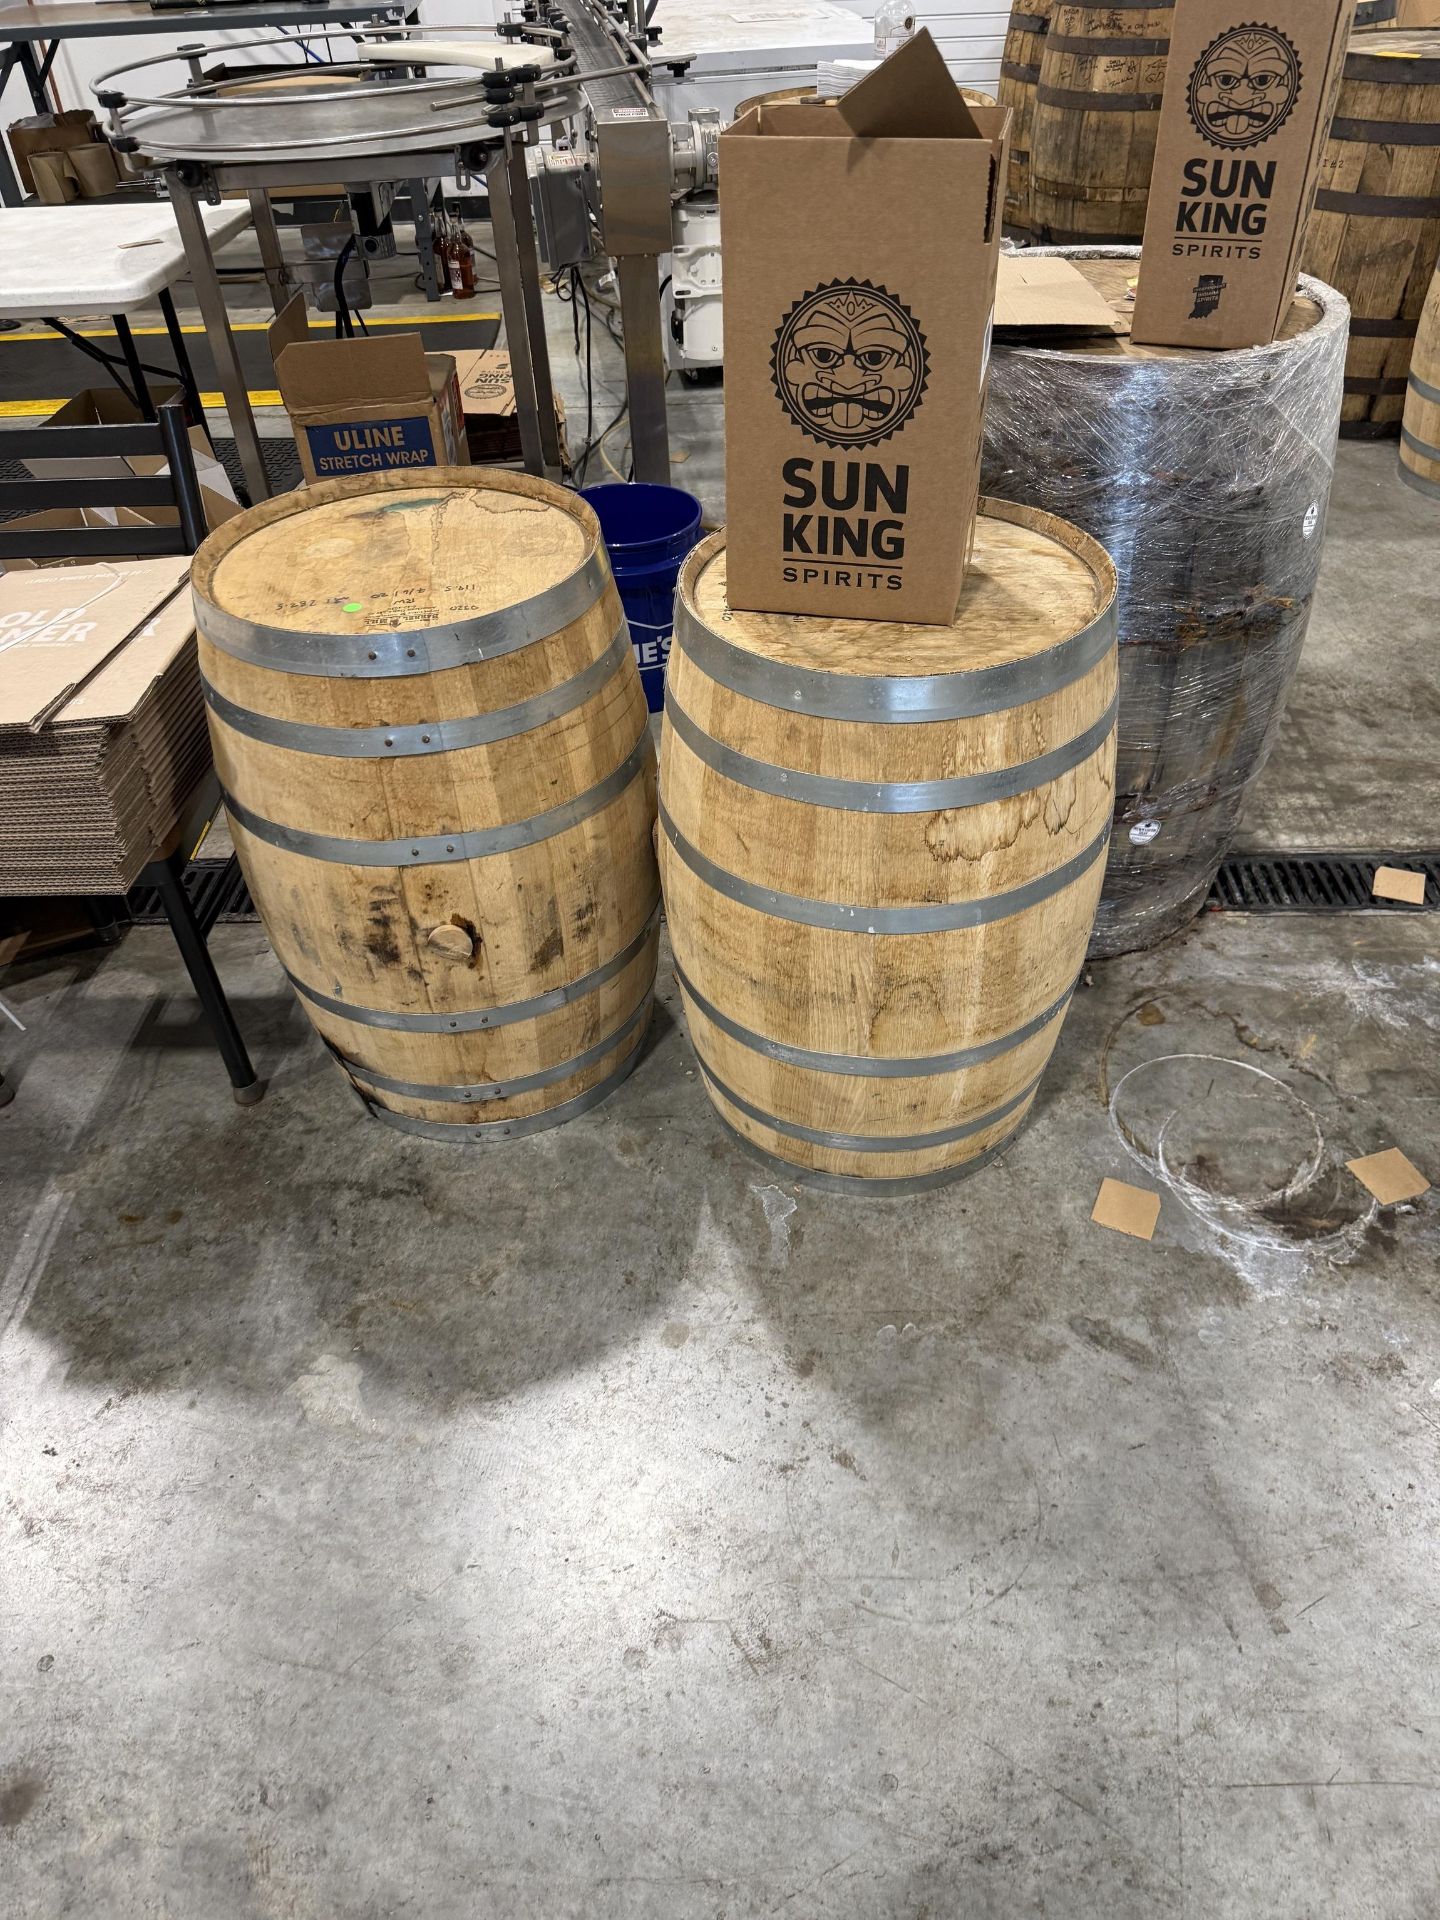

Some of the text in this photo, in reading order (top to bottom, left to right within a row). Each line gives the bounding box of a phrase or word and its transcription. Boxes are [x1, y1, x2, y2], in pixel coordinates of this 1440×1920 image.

[1181, 158, 1277, 199] SUN
[1176, 201, 1267, 235] KING
[1172, 244, 1261, 259] SPIRITS
[333, 425, 405, 451] ULINE
[319, 449, 428, 471] STRETCH WRAP
[782, 457, 909, 514] SUN
[783, 513, 905, 560] KING
[783, 567, 903, 591] SPIRITS
[0, 608, 87, 628] OLD
[632, 635, 673, 664] E'S
